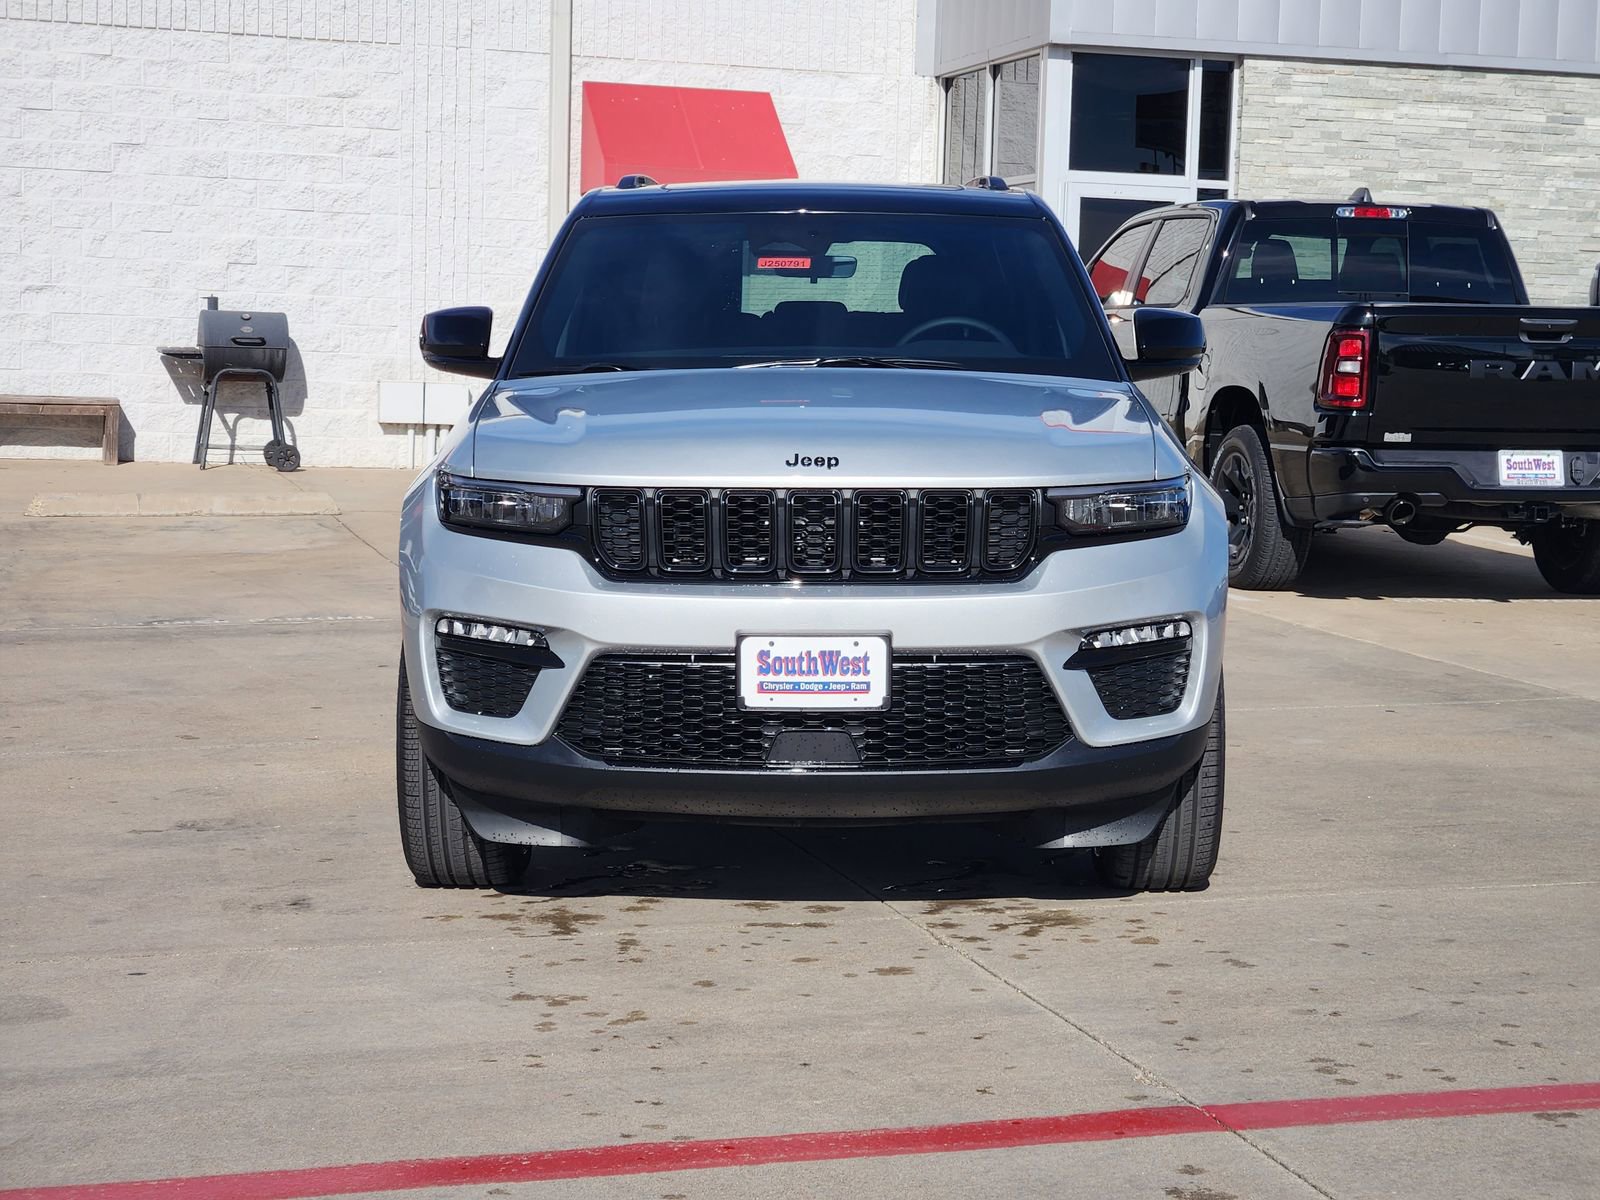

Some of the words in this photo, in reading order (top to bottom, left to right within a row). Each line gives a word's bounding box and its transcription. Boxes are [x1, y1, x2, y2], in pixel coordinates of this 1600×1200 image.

[785, 453, 840, 470] Jeep
[1506, 458, 1556, 471] SouthWest
[757, 650, 871, 677] SouthWest
[763, 682, 794, 691] Chrysler
[800, 682, 824, 692] Dodge
[829, 682, 846, 692] Jeep
[851, 682, 868, 690] Ram
